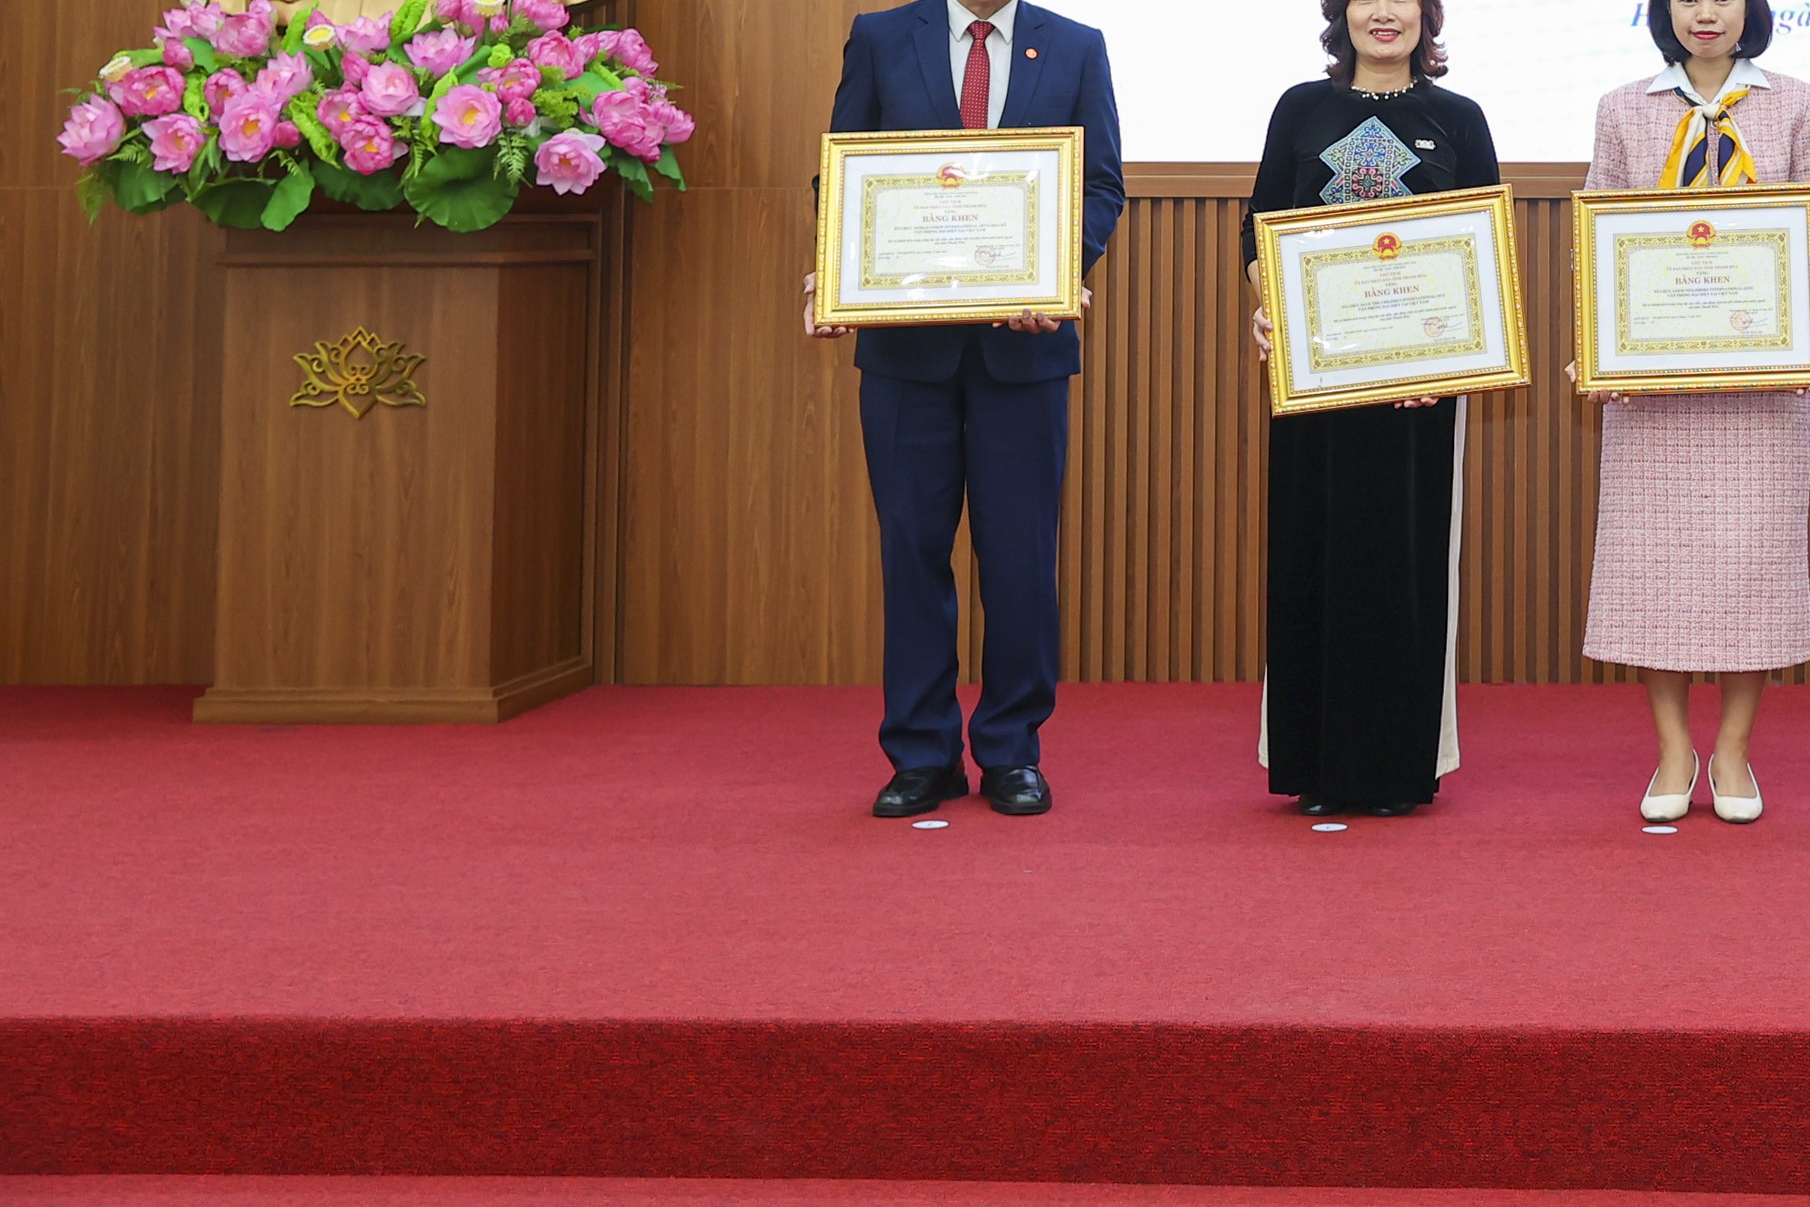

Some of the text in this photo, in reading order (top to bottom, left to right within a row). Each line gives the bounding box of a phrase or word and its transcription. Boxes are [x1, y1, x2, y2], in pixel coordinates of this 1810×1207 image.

[951, 212, 979, 222] KHEN
[1703, 275, 1731, 284] KHEN
[1392, 283, 1420, 296] KHEN
